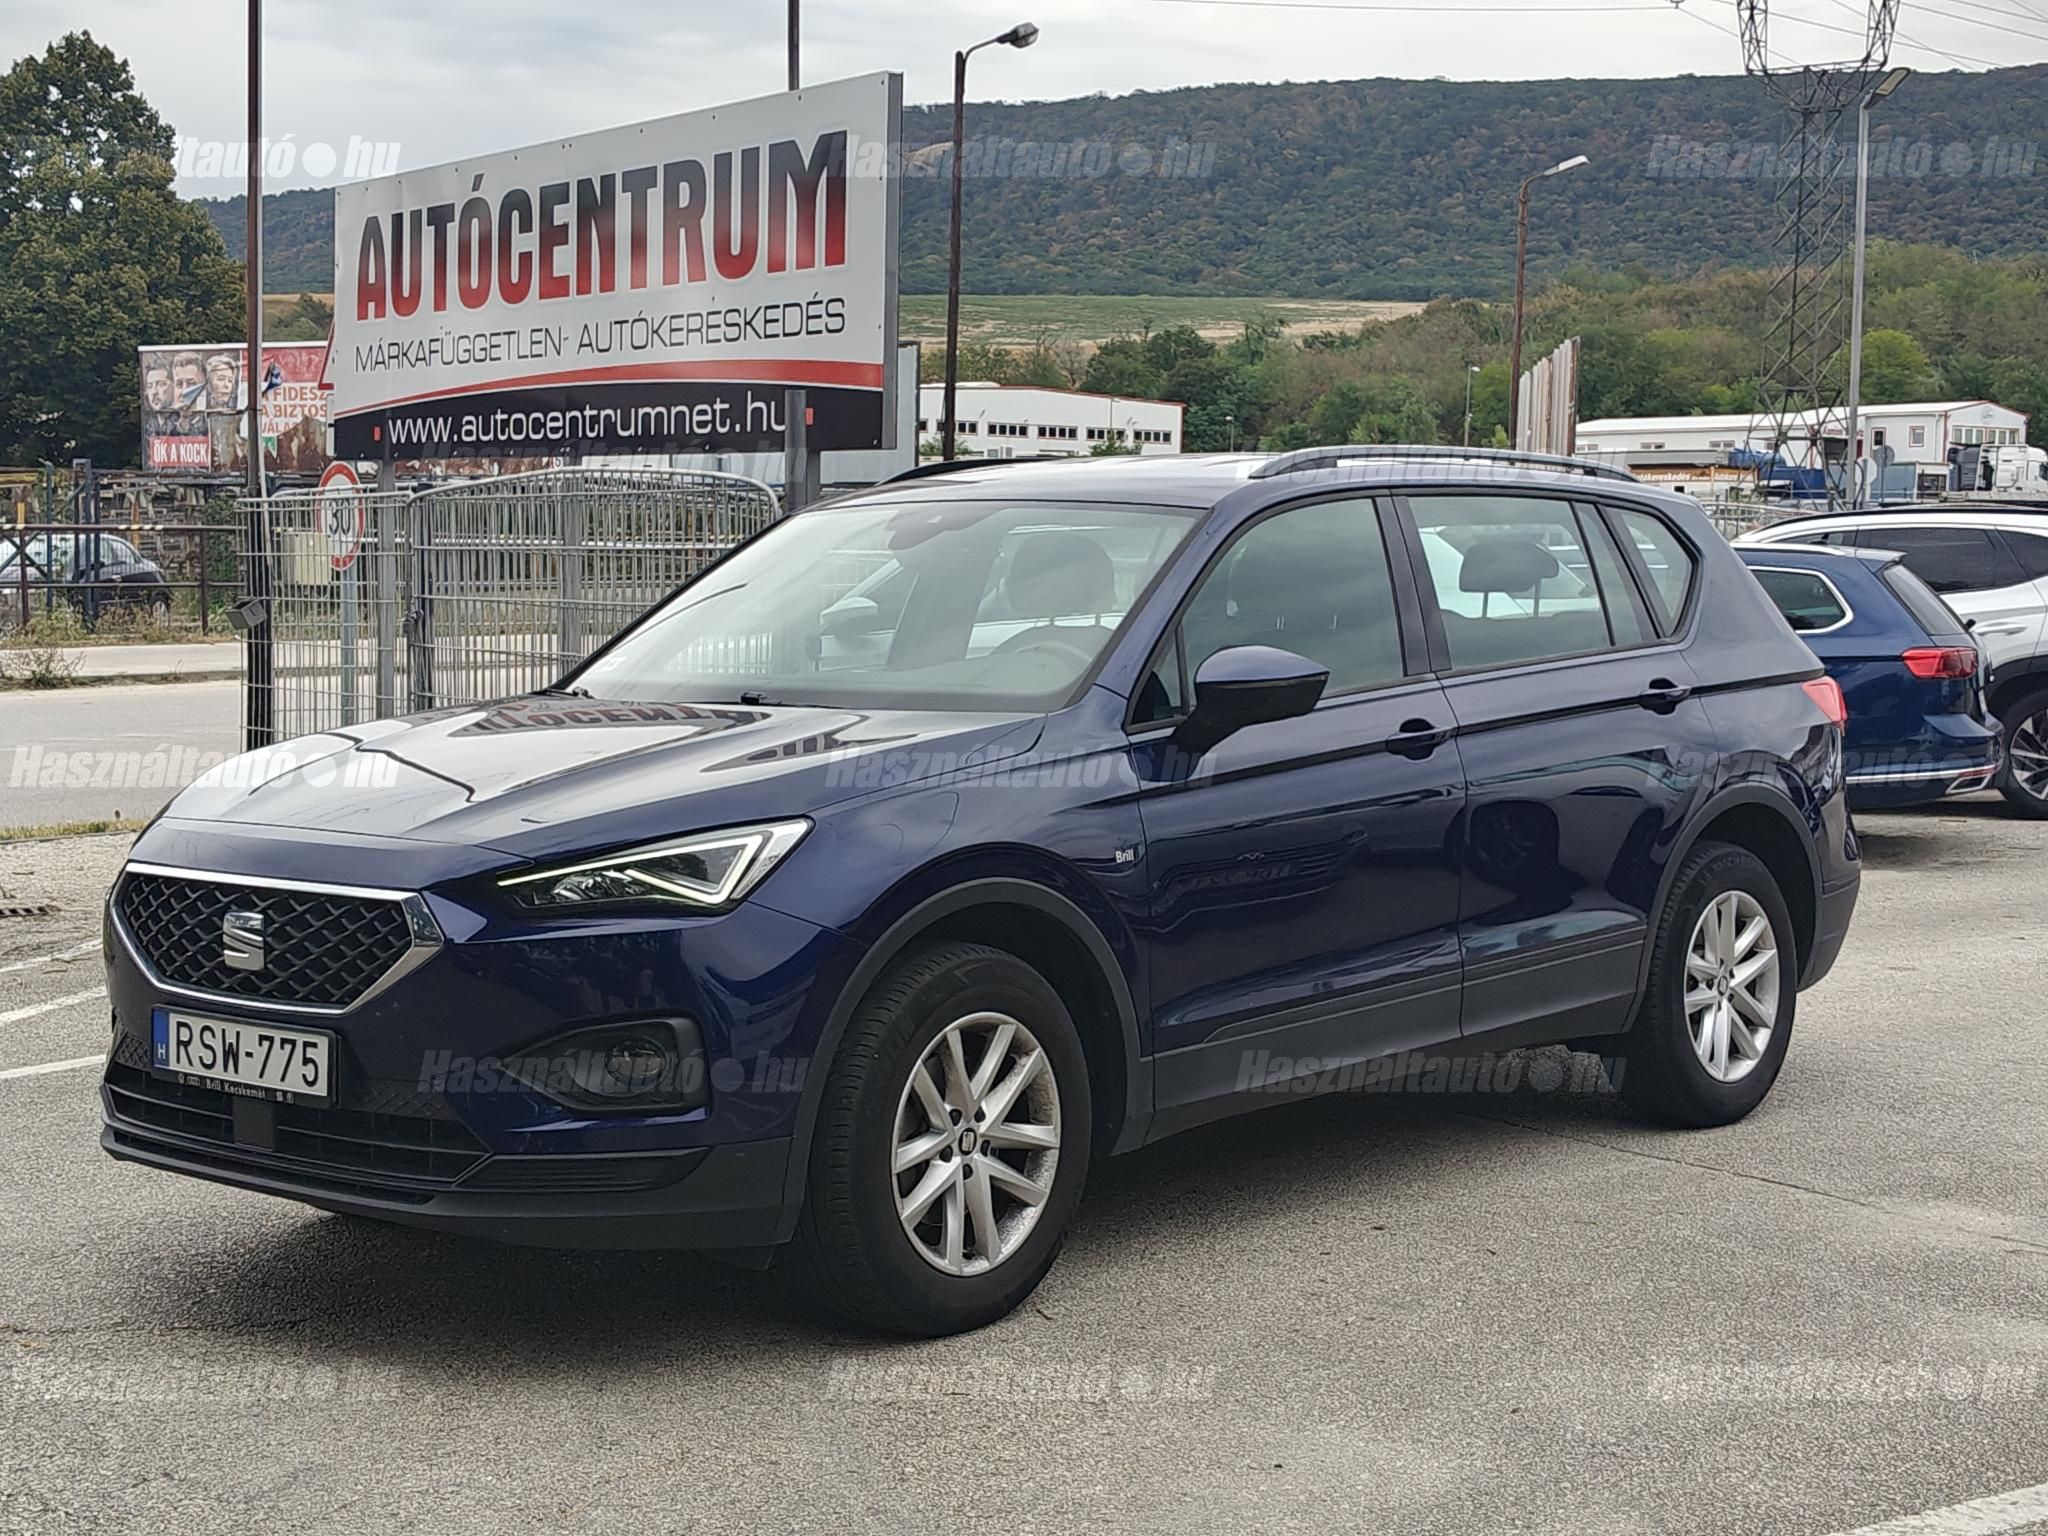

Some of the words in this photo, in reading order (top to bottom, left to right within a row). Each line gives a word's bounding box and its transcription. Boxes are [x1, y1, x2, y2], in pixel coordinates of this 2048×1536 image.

[356, 130, 848, 321] AUTÓCENTRUM
[577, 292, 845, 355] AUTÓKERESKEDÉS
[274, 404, 327, 417] BIZTOS
[388, 390, 786, 444] www.autocentrumnet.hu
[170, 443, 178, 463] A
[180, 443, 208, 463] KOCK
[328, 499, 351, 535] 30
[1115, 847, 1134, 863] Brill
[157, 1043, 166, 1060] H
[175, 1020, 319, 1088] RSW-775
